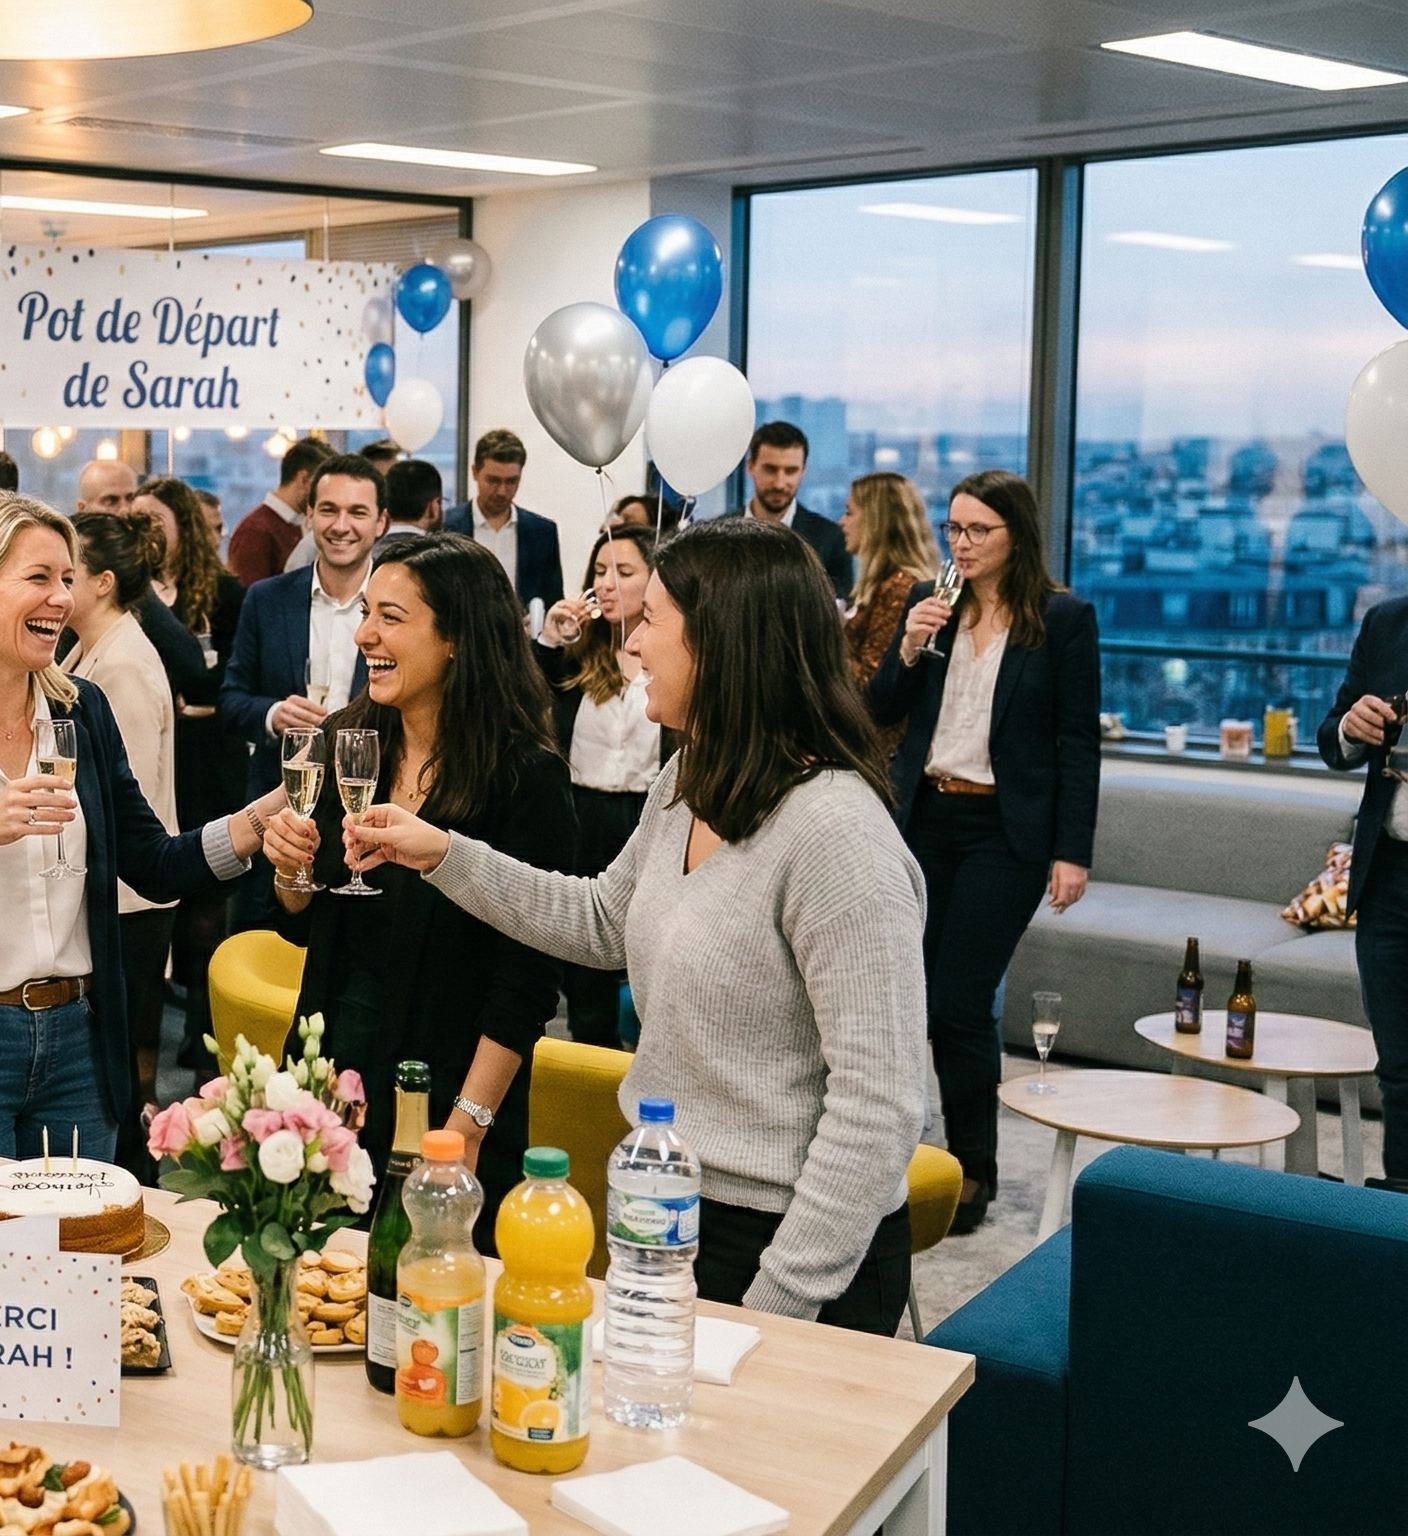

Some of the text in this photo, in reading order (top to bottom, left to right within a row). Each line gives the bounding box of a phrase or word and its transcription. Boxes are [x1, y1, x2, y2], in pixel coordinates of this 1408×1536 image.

[18, 291, 280, 359] Pot de Départ
[63, 360, 240, 409] de Sarah
[65, 1347, 72, 1369] !
